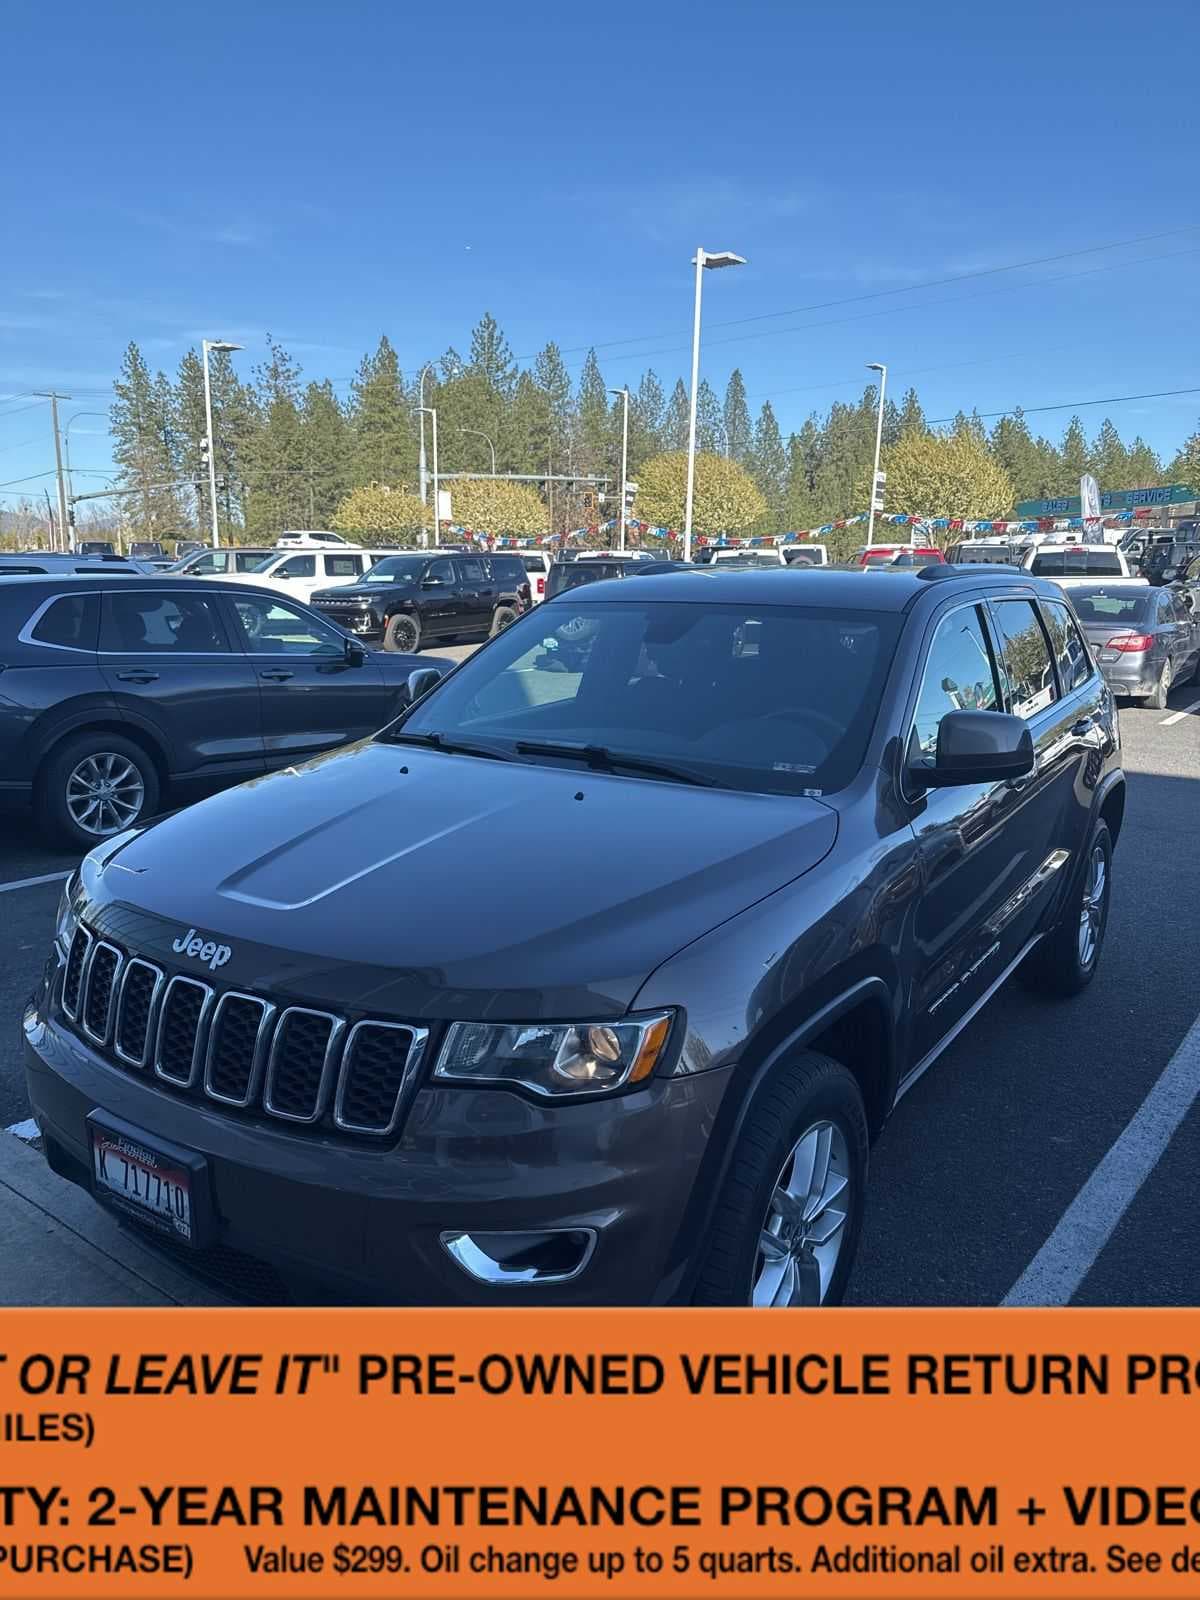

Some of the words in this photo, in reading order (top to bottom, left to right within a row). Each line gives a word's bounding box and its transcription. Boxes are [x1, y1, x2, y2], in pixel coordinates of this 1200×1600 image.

[1126, 488, 1173, 505] SERVICE
[172, 928, 232, 971] Jeep
[99, 1148, 109, 1181] K
[120, 1158, 185, 1219] 717710
